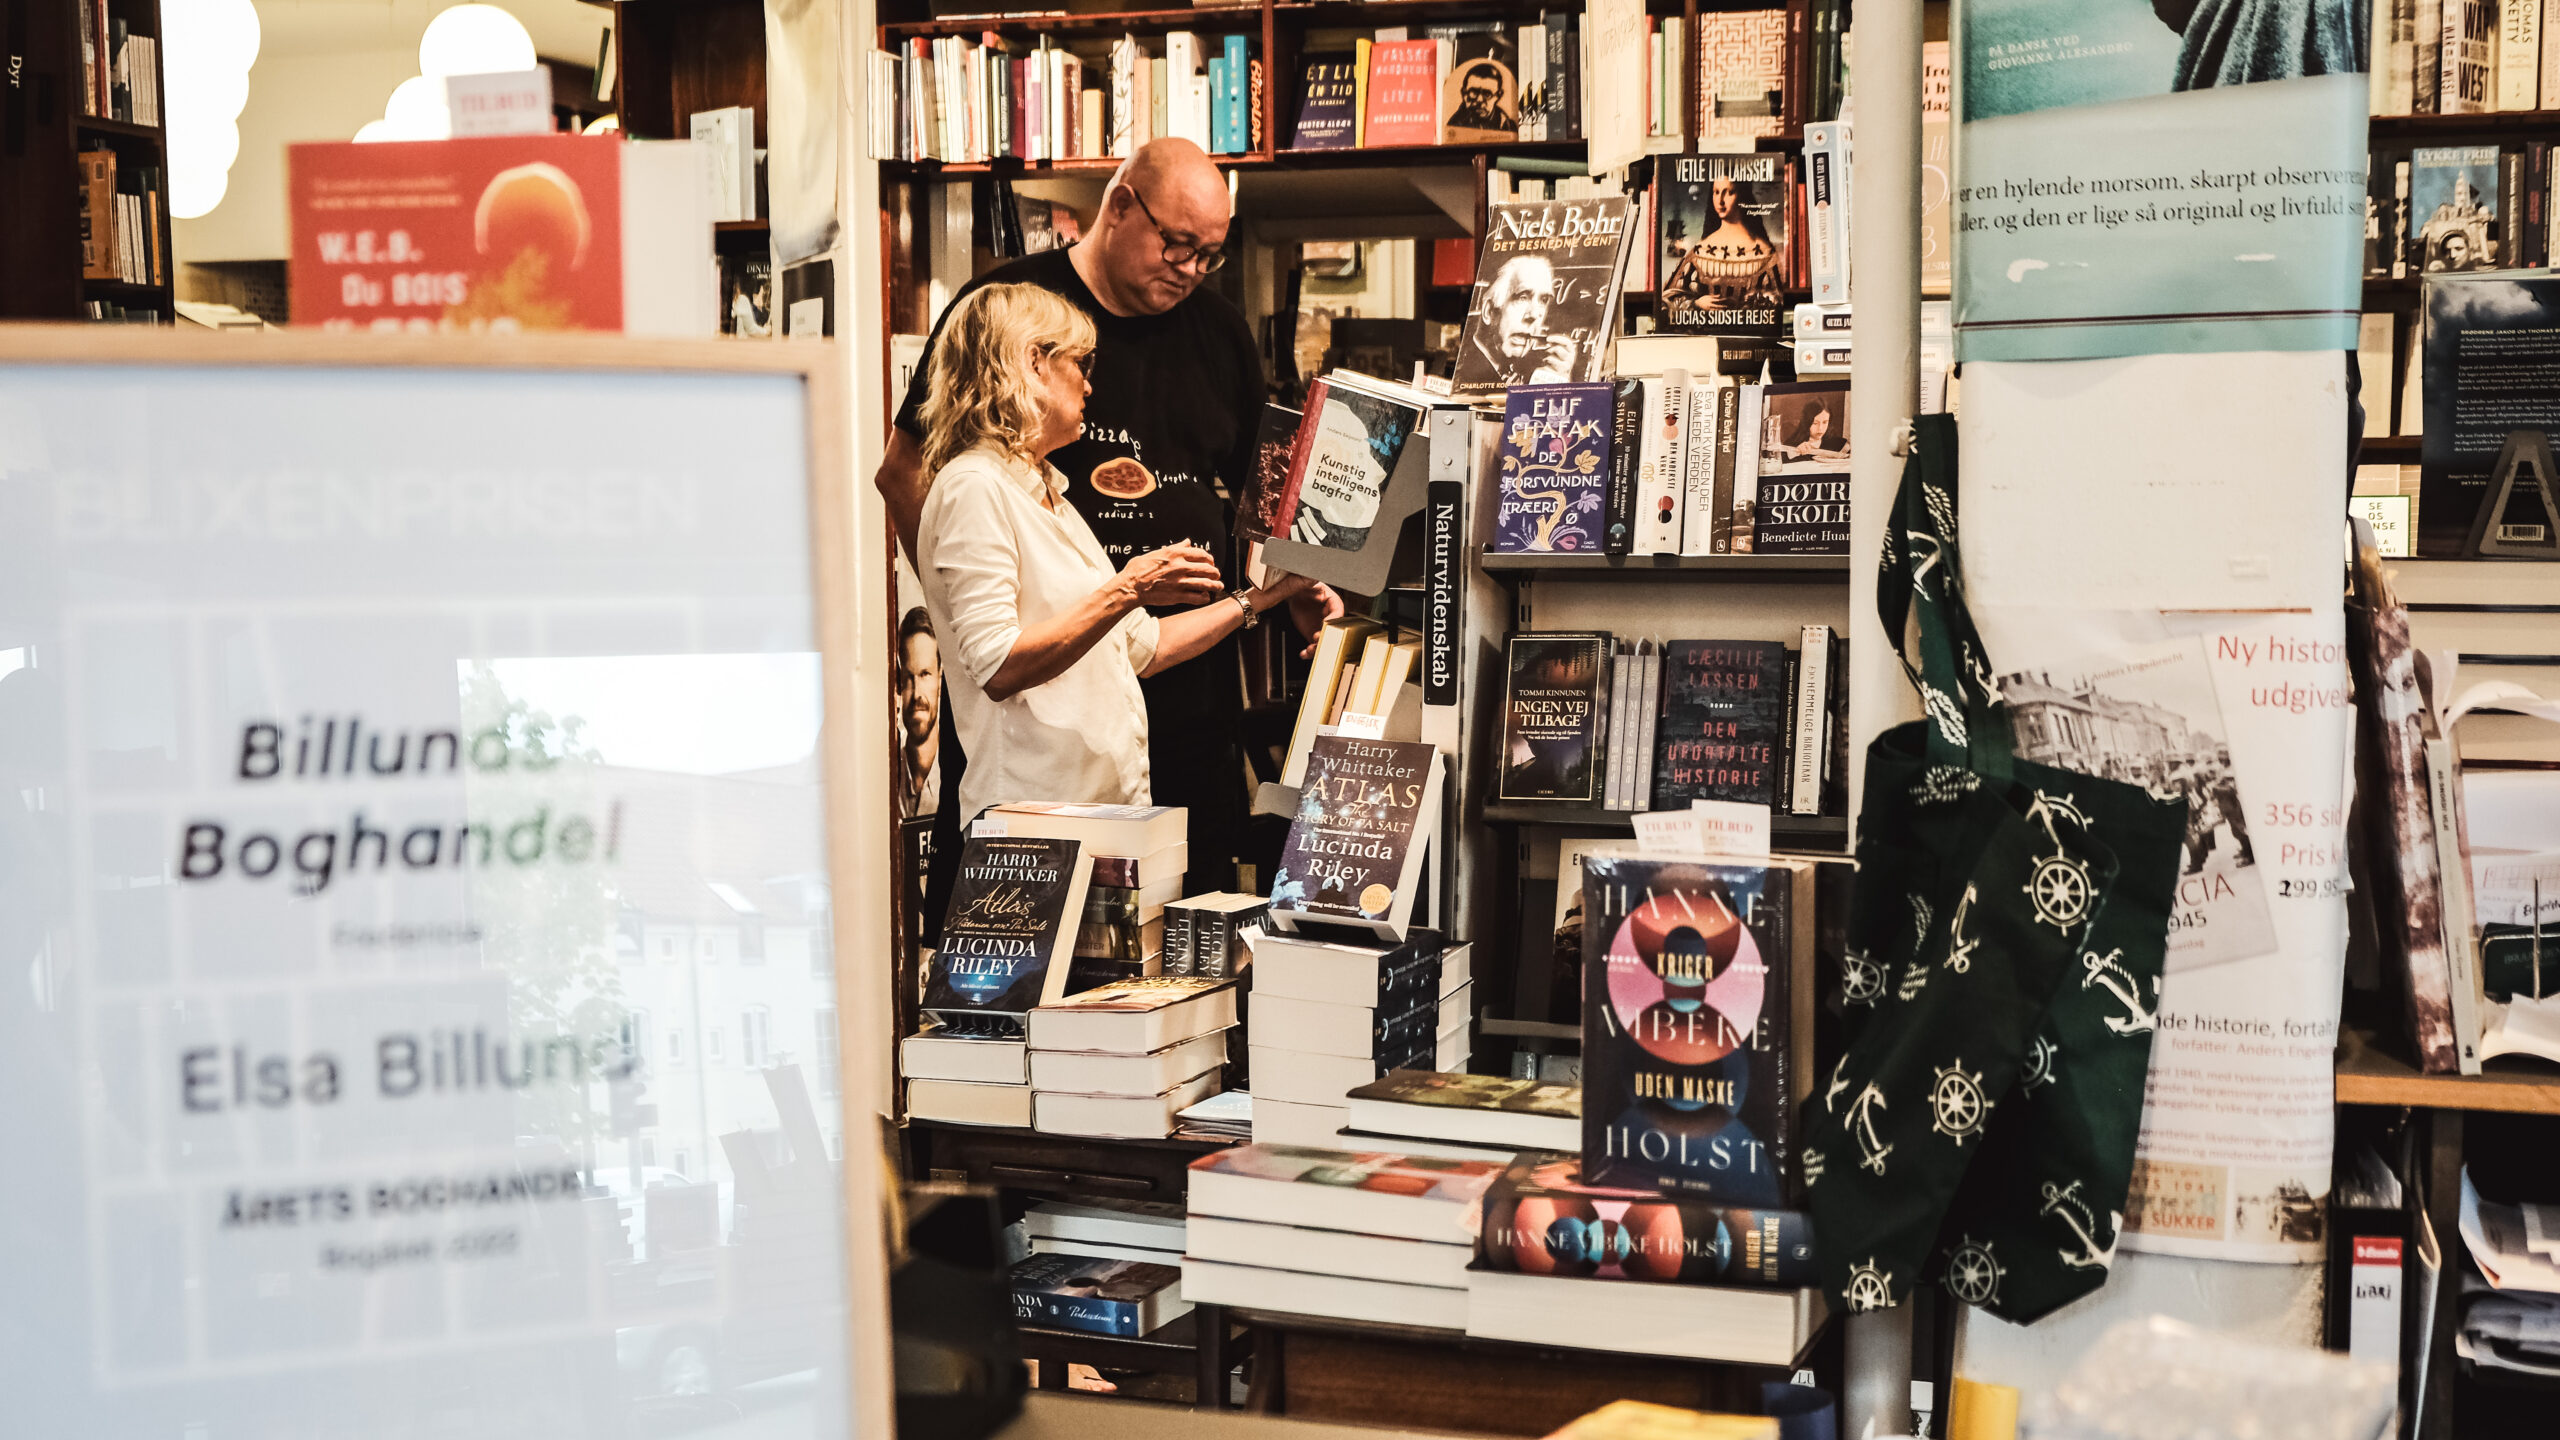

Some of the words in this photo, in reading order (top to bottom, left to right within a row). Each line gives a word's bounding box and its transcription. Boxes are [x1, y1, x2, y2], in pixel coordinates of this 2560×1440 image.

[2007, 39, 2049, 53] DANSK
[2053, 35, 2079, 47] VED
[8, 55, 22, 88] Dyr
[1988, 53, 2054, 70] GIOVANNA
[2458, 62, 2490, 103] WEST
[1675, 158, 1706, 182] VETLE
[1728, 157, 1775, 182] LARSSEN
[1976, 186, 1998, 200] en
[2004, 175, 2084, 203] hylende
[2091, 175, 2184, 194] morsom,
[2190, 168, 2257, 193] skarpt
[1493, 207, 1556, 241] Niels
[1559, 203, 1622, 238] Bohr
[1993, 215, 2019, 234] og
[2022, 207, 2061, 228] den
[2067, 211, 2087, 225] er
[2093, 204, 2129, 230] lige
[2135, 202, 2157, 223] så
[2163, 198, 2244, 226] original
[2250, 201, 2277, 224] og
[2281, 194, 2344, 216] livfuld
[317, 232, 424, 264] W.E.B.
[1493, 240, 1515, 252] DET
[1518, 237, 1580, 251] BESKEDNE
[1583, 235, 1612, 248] GENI
[1822, 284, 1830, 293] P
[1669, 309, 1706, 325] LUCIAS
[1707, 309, 1744, 325] SIDSTE
[1745, 309, 1775, 325] REJSE
[1459, 382, 1495, 390] CHARLOTTE
[1533, 398, 1583, 418] ELIF
[1705, 391, 1714, 410] Eva
[1724, 391, 1734, 419] Ophav
[1614, 401, 1625, 445] SHAFAK
[1626, 411, 1637, 436] ELIF
[1691, 391, 1704, 444] SAMLEDE
[1703, 411, 1713, 435] Tind
[1723, 419, 1732, 432] Eva
[1507, 419, 1605, 440] SHAFAK
[1722, 433, 1732, 453] Tind
[1320, 453, 1366, 481] Kunstig
[1538, 451, 1558, 464] DE
[1700, 436, 1712, 487] KVINDEN
[1163, 472, 1189, 485] depth
[1689, 446, 1701, 493] VERDEN
[1311, 479, 1352, 503] bagfra
[1315, 465, 1378, 498] intelligens
[1505, 475, 1602, 489] FORSVUNDNE
[1773, 482, 1851, 503] DØTR
[1503, 501, 1558, 515] TRÆERS
[1699, 490, 1709, 512] DER
[1098, 510, 1134, 519] radius
[1565, 512, 1578, 526] Ø
[1761, 532, 1817, 544] Benedicte
[1431, 503, 1454, 687] Naturvidenskab
[1688, 650, 1763, 667] CÆCILIE
[2218, 635, 2257, 667] Ny
[2269, 635, 2346, 663] histor
[1690, 672, 1758, 690] LASSEN
[1519, 689, 1545, 697] TOMMI
[1546, 689, 1586, 697] KINNUNEN
[1513, 700, 1562, 713] INGEN
[1565, 701, 1589, 717] VEJ
[1803, 682, 1816, 733] HEMMELIGE
[1520, 714, 1581, 727] TILBAGE
[1704, 721, 1737, 738] DEN
[1345, 742, 1398, 761] Harry
[1668, 744, 1770, 764] UFORTALTE
[1801, 736, 1814, 783] BIBLIOTEKAR
[1321, 757, 1416, 779] Whittaker
[1674, 768, 1761, 787] HISTORIE
[1303, 776, 1421, 809] ATLAS
[1338, 816, 1355, 828] OF
[1376, 820, 1410, 833] SALT
[2264, 803, 2313, 827] 356
[1706, 819, 1753, 834] TILBUD
[178, 800, 628, 897] Boghandel
[1296, 833, 1393, 861] Lucinda
[2281, 842, 2324, 866] Pris
[986, 853, 1042, 868] HARRY
[964, 867, 1058, 883] WHITTAKER
[1306, 857, 1371, 887] Riley
[956, 882, 1036, 916] Atlas
[1298, 899, 1323, 909] Everything
[1604, 884, 1765, 927] HANNE
[943, 916, 991, 932] Historien
[992, 922, 1008, 930] om
[1025, 918, 1049, 932] Salt
[942, 937, 1036, 958] LUCINDA
[1164, 927, 1177, 968] RILEY
[1176, 918, 1190, 974] LUCIND
[1198, 931, 1211, 972] RILEY
[1210, 921, 1224, 977] LUCIND
[950, 957, 1020, 976] RILEY
[1657, 952, 1713, 980] KRIGER
[1601, 1004, 1771, 1051] VIBEKE
[2157, 1012, 2187, 1031] nde
[2194, 1013, 2276, 1039] historie,
[2235, 1043, 2285, 1057] Anders
[180, 1045, 343, 1115] Elsa
[2206, 1070, 2232, 1082] med
[1635, 1072, 1675, 1099] UDEN
[1682, 1076, 1735, 1106] MASKE
[2246, 1106, 2260, 1117] og
[1606, 1125, 1765, 1174] HOLST
[2192, 1147, 2206, 1159] og
[220, 1186, 353, 1231] ÅRETS
[2151, 1214, 2216, 1231] SUKKER
[1497, 1228, 1570, 1251] HANNE
[1658, 1233, 1732, 1259] HOLST
